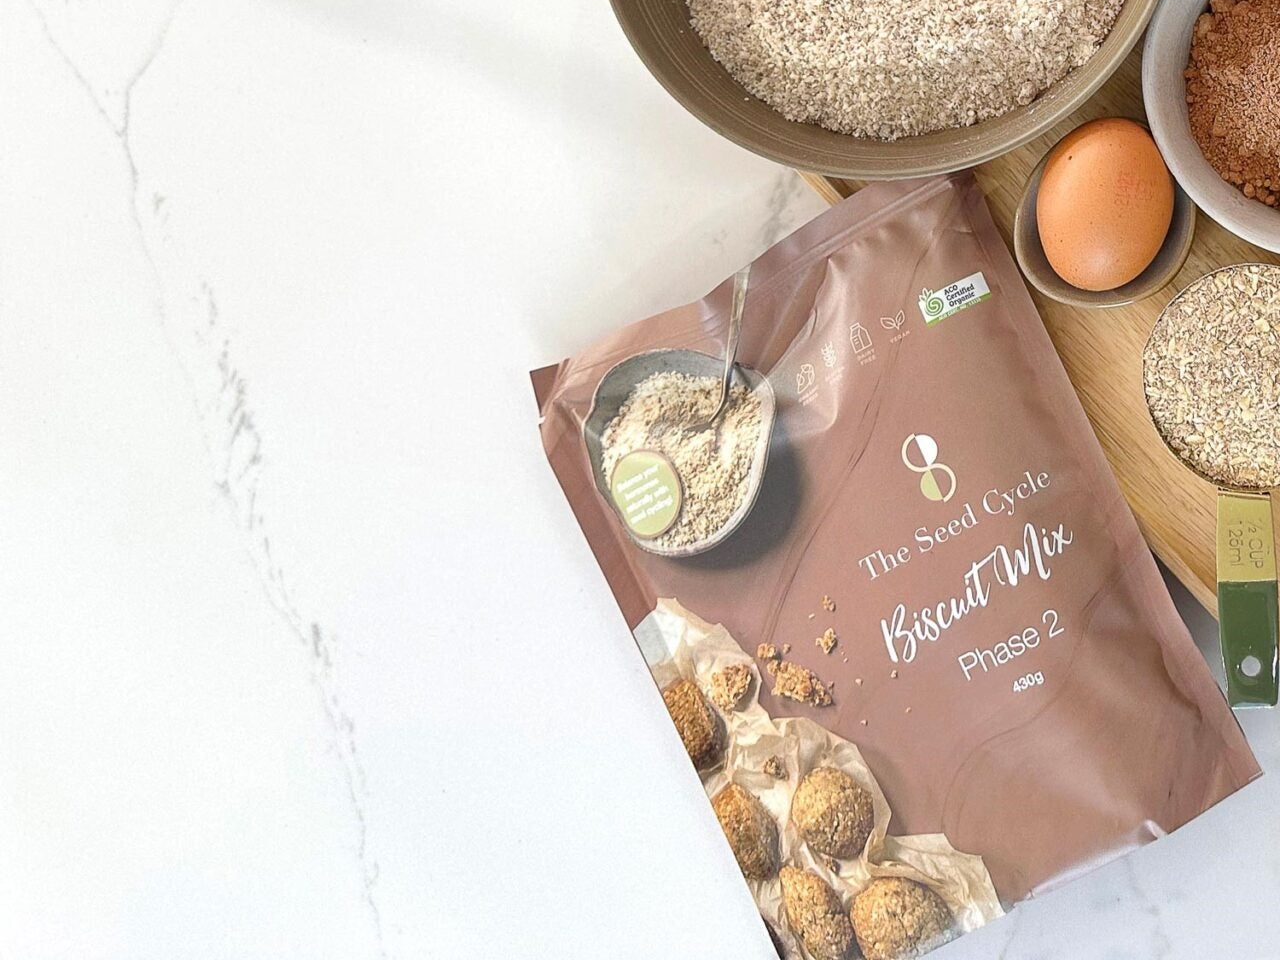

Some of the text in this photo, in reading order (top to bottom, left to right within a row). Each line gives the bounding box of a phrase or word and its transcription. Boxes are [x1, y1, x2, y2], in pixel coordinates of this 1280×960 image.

[944, 284, 958, 295] ACO
[946, 283, 975, 301] Certified
[949, 291, 975, 307] Organic
[858, 471, 1051, 581] The Seed Cycle
[1248, 538, 1264, 569] CUP
[880, 522, 1073, 663] Biscuit Mix
[957, 609, 1065, 681] Phase 2
[1012, 670, 1044, 693] 430g
